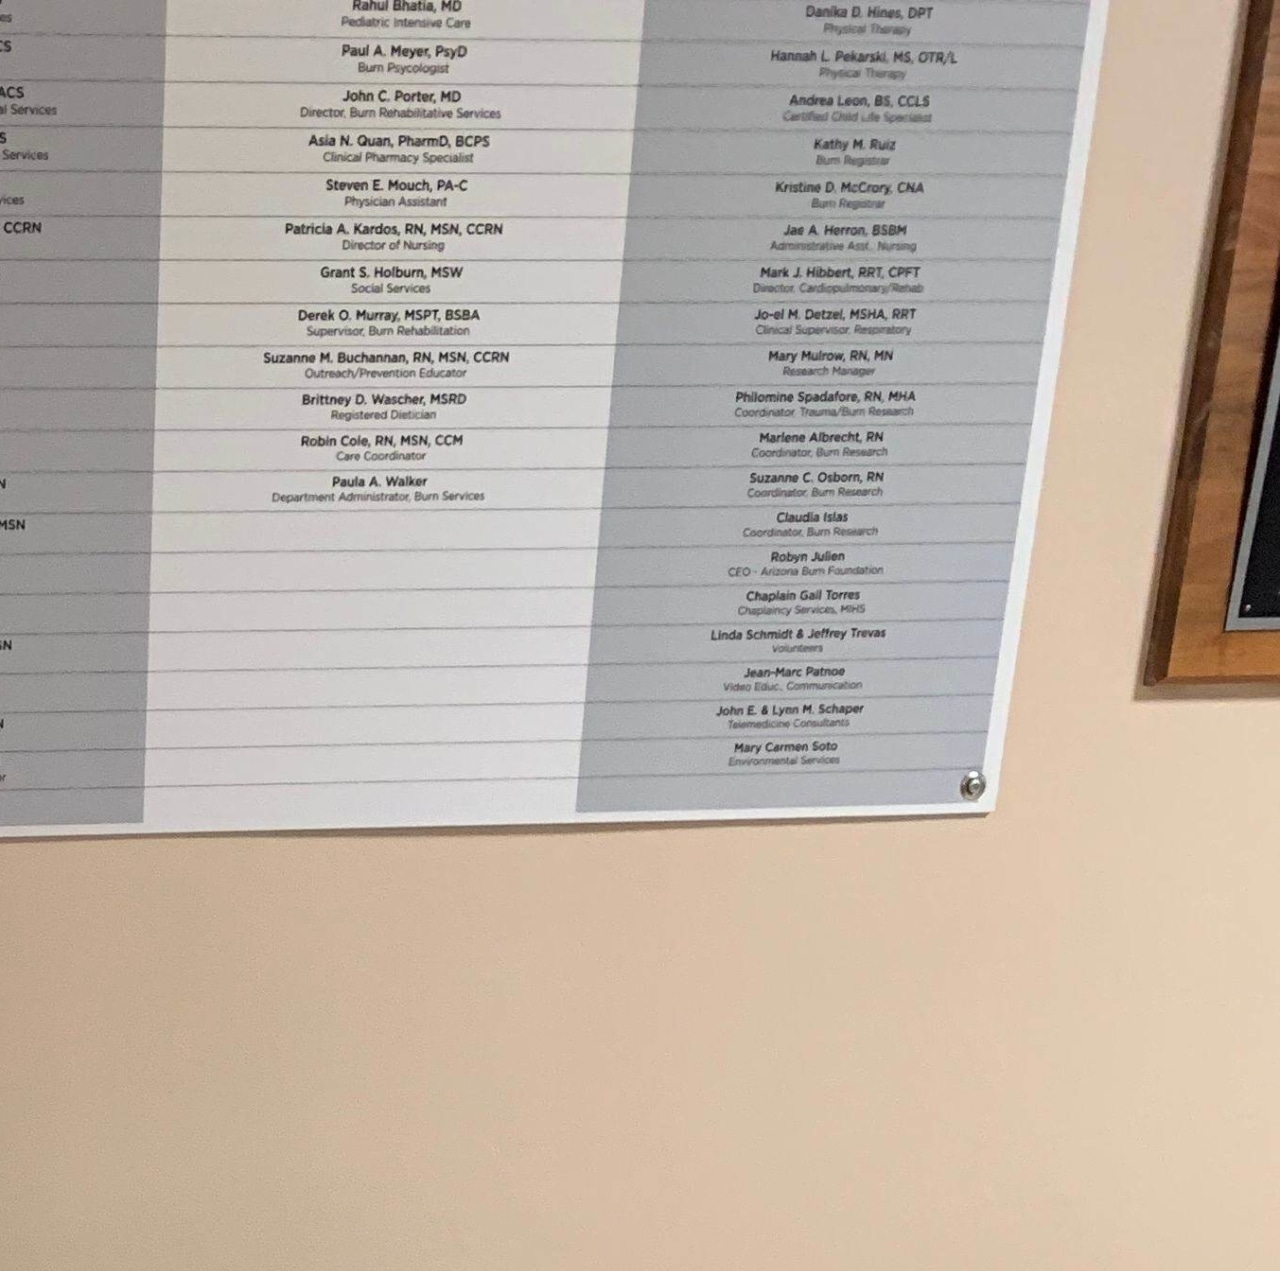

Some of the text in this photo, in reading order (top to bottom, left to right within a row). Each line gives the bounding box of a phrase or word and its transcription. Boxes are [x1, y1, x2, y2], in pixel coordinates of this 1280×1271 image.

[352, 0, 389, 11] Rahul
[441, 0, 462, 12] MD
[342, 44, 369, 56] Paul
[373, 45, 386, 56] A.
[435, 45, 467, 60] PsyD
[358, 62, 384, 73] Burn
[342, 90, 374, 102] John
[377, 90, 390, 102] C.
[440, 91, 461, 103] MD
[10, 103, 57, 115] Services
[308, 135, 336, 146] Asia
[340, 135, 353, 146] N.
[455, 135, 490, 147] BCPS
[323, 151, 474, 165] Clinical Pharmacy Specialist
[326, 179, 369, 191] Steven
[437, 179, 468, 191] PA-C
[3, 221, 42, 234] CCRN
[320, 266, 355, 278] Grant
[359, 266, 370, 278] S.
[431, 266, 463, 278] MSW
[760, 267, 789, 278] Mark
[793, 267, 802, 278] J.
[888, 266, 921, 278] CPFT
[298, 309, 335, 321] Derek
[339, 309, 351, 321] O.
[445, 309, 480, 321] BSBA
[264, 352, 316, 363] Suzanne
[320, 352, 333, 363] M.
[473, 351, 509, 363] CCRN
[769, 351, 798, 363] Mary
[874, 350, 893, 361] MN
[305, 367, 467, 379] Outreach/Prevention Educator
[302, 394, 351, 407] Brittney
[355, 394, 367, 405] D.
[430, 393, 467, 405] MSRD
[888, 391, 916, 401] MHA
[759, 432, 806, 443] Marlene
[866, 431, 884, 442] RN
[332, 476, 428, 487] Paula A. Walker
[777, 512, 820, 523] Claudia
[771, 551, 808, 564] Robyn
[746, 590, 860, 603] Chaplain Gail Torres
[744, 667, 802, 678] Jean-Marc
[734, 741, 838, 754] Mary Carmen Soto
